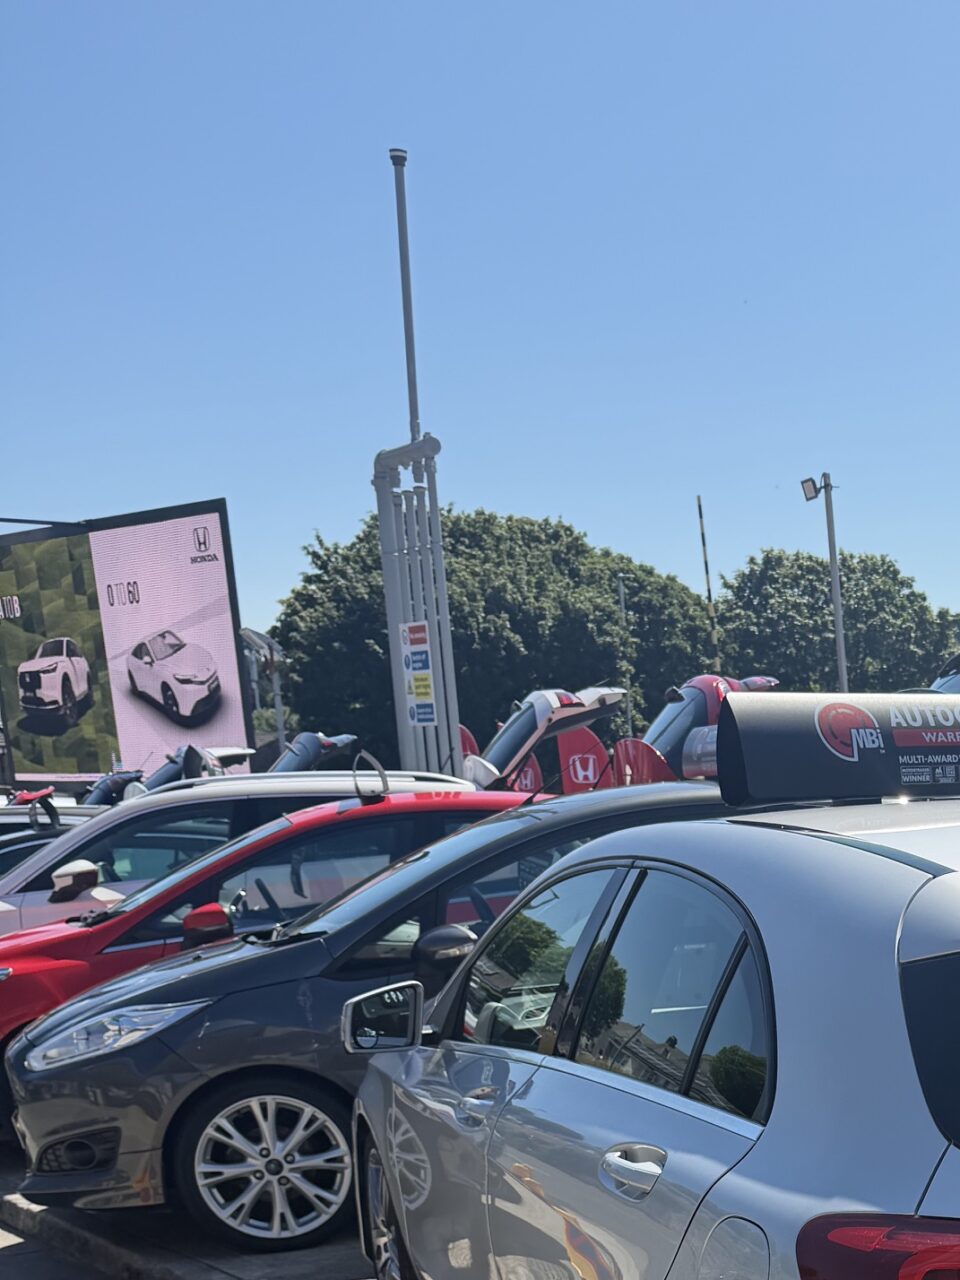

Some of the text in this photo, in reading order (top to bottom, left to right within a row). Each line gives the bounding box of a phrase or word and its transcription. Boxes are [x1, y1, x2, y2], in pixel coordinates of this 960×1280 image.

[190, 553, 219, 564] HONDA
[114, 582, 127, 606] TO
[127, 581, 141, 604] 60
[12, 595, 21, 618] B
[851, 729, 884, 750] MBi
[899, 755, 958, 764] MULTI-AWARD
